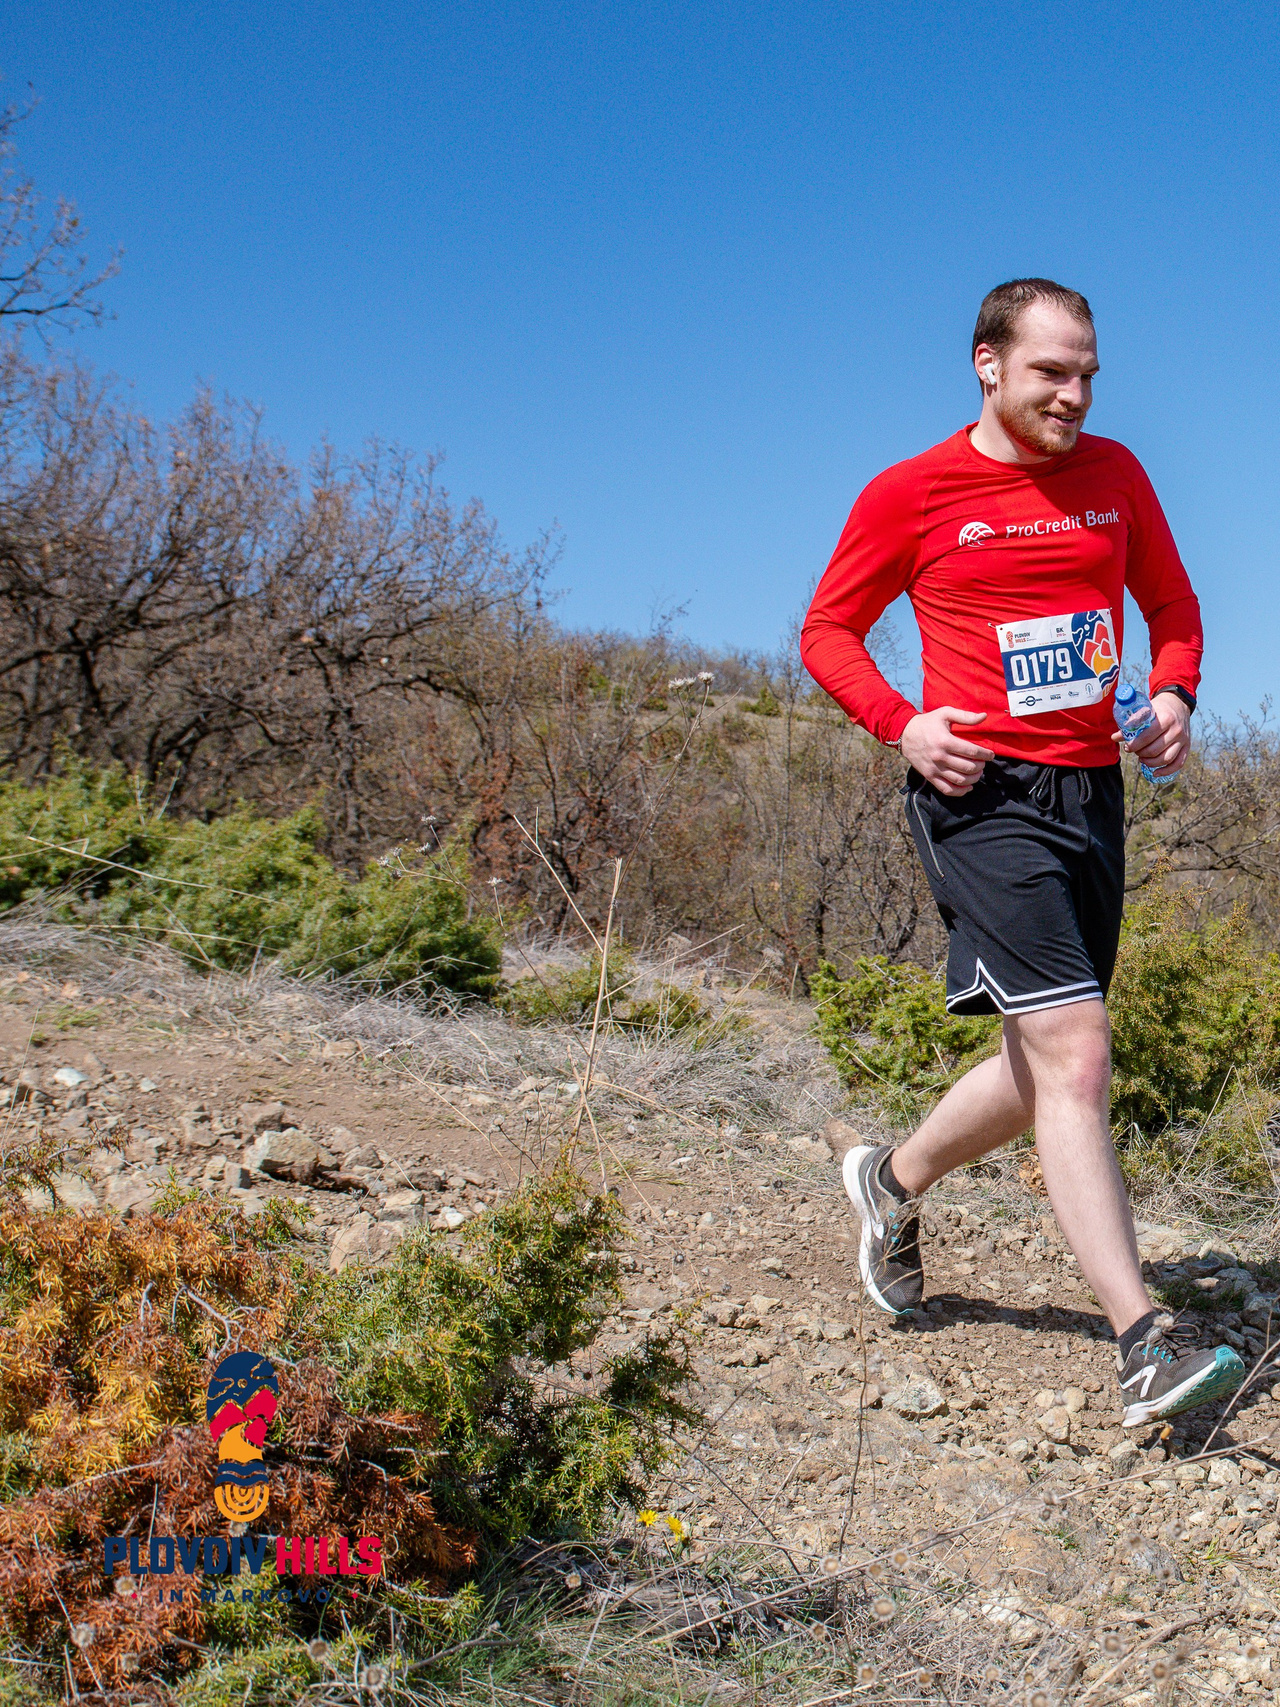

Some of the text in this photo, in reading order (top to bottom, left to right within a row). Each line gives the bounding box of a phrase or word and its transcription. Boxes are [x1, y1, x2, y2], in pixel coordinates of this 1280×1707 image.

[1005, 508, 1119, 538] ProCredit Bank
[1010, 647, 1073, 687] 0179
